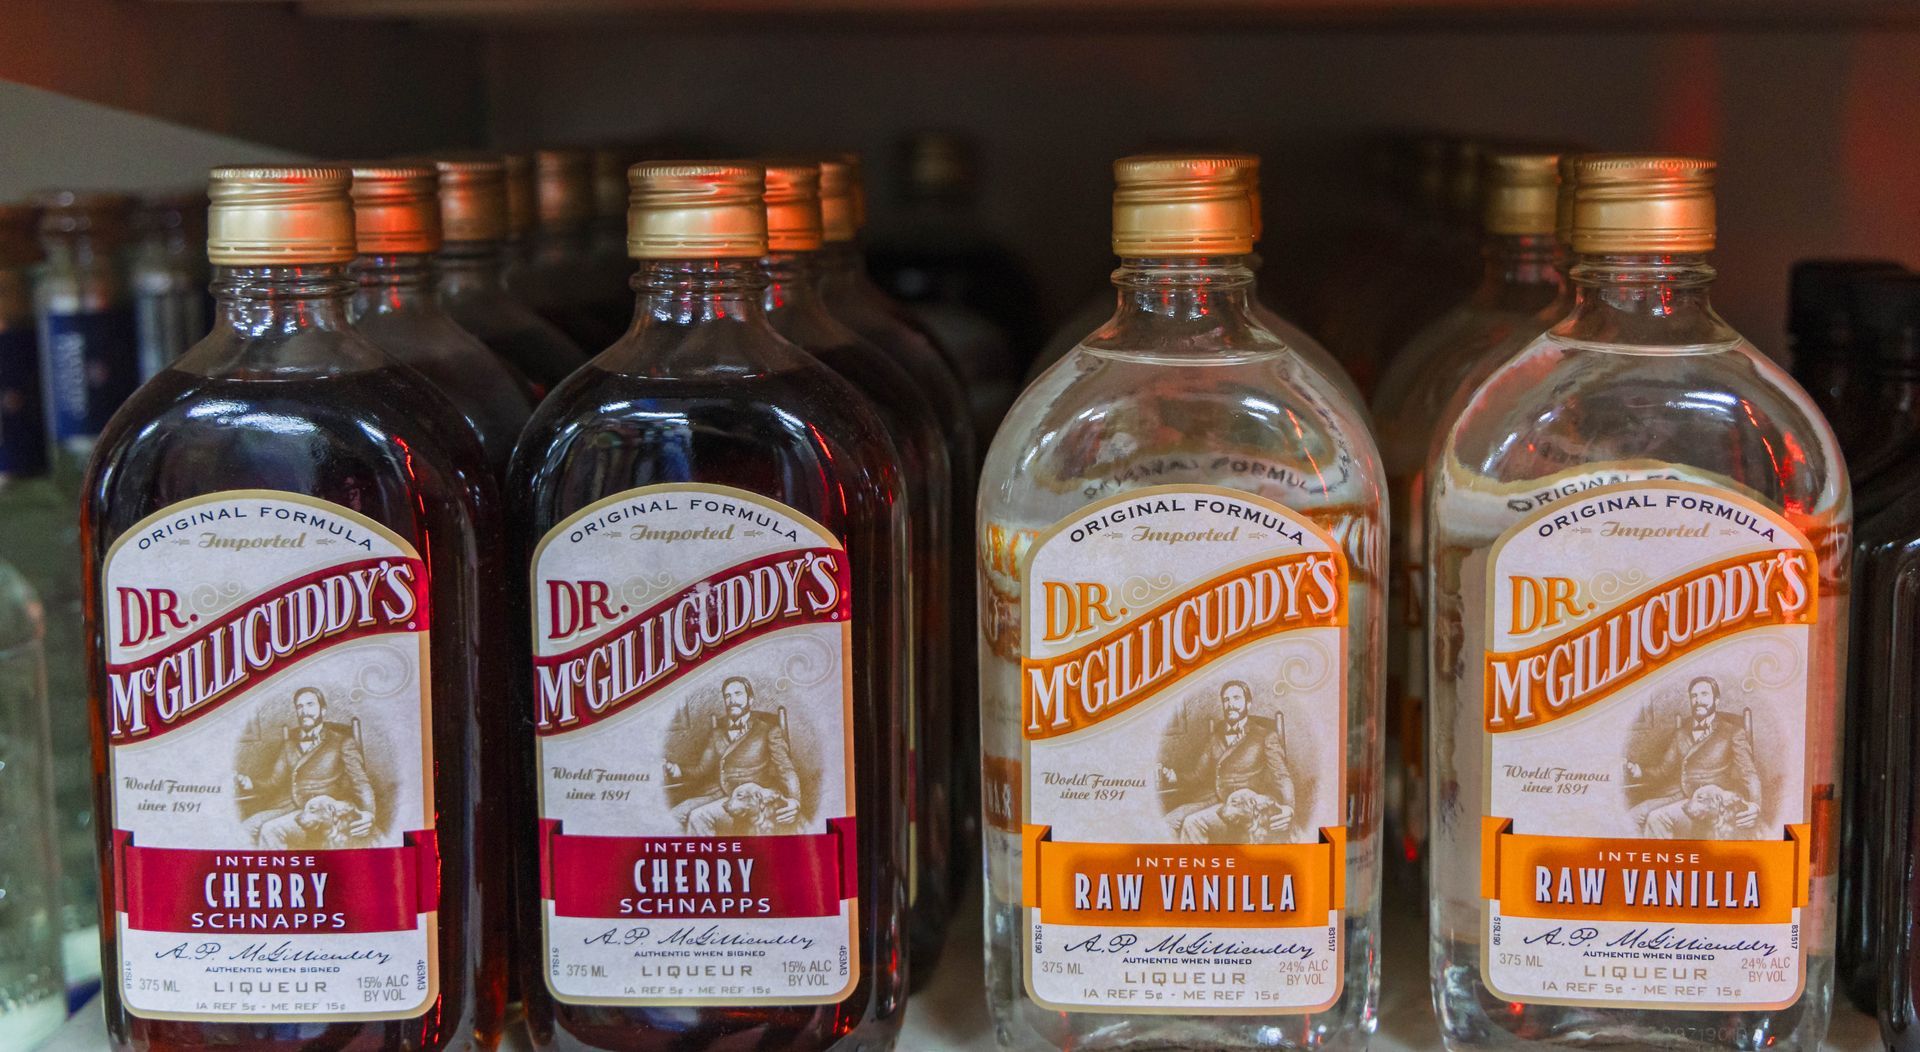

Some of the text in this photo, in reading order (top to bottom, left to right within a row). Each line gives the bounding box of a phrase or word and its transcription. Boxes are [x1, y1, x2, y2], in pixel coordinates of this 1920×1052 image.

[570, 499, 798, 543] ORIGINAL FORMULA
[1069, 499, 1304, 546] ORIGINAL FORMULA
[1538, 495, 1776, 543] ORIGINAL FORMULA
[138, 507, 372, 551] ORIGINAL FORMULA
[630, 524, 735, 544] Imported
[1131, 525, 1239, 545] Imported
[1600, 521, 1709, 540] Imported
[199, 532, 306, 551] Imported
[546, 580, 629, 639] DR.
[1042, 581, 1128, 641] DR.
[1508, 575, 1595, 634] DR.
[116, 586, 198, 647] DR.
[551, 766, 650, 783] World Famous
[1041, 772, 1147, 787] World Famous
[1503, 765, 1611, 782] World Famous
[123, 777, 222, 794] World Famous
[1521, 782, 1589, 795] since 1891
[566, 788, 630, 801] since 1891
[1059, 788, 1125, 801] since 1891
[137, 799, 201, 813] since 1891
[644, 842, 742, 852] INTENSE
[216, 855, 316, 867] INTENSE
[1136, 857, 1235, 868] INTENSE
[1599, 852, 1700, 864] INTENSE
[633, 858, 754, 893] CHERRY
[204, 872, 329, 908] CHERRY
[1075, 873, 1297, 912] RAW VANILLA
[1535, 865, 1759, 907] RAW VANILLA
[620, 898, 771, 913] SCHNAPPS
[191, 912, 346, 929] SCHNAPPS
[1328, 927, 1336, 951] 831517
[1493, 917, 1501, 946] 51SL190
[838, 945, 848, 976] 463M3
[1500, 953, 1543, 967] 375 ML
[1583, 951, 1639, 959] AUTHENTIC
[567, 964, 608, 978] 375 ML
[782, 960, 832, 973] 15% ALC
[1042, 961, 1084, 975] 375 ML
[1279, 959, 1328, 973] 24% ALC
[1741, 957, 1791, 970] 24% ALC
[417, 959, 426, 990] 463M3
[642, 966, 753, 978] LIQUEUR
[1125, 972, 1246, 985] LIQUEUR
[1286, 973, 1324, 986] BY VOL
[1584, 965, 1707, 980] LIQUEUR
[1749, 970, 1786, 982] BY VOL
[140, 979, 180, 992] 375 ML
[357, 974, 409, 989] 15% ALC
[788, 974, 829, 986] BY VOL
[214, 981, 327, 995] LIQUEUR
[364, 988, 406, 1002] BY VOL
[1084, 989, 1099, 998] IA
[1107, 989, 1137, 998] REF
[1184, 991, 1206, 1000] ME
[1214, 991, 1245, 1000] REF
[1542, 981, 1558, 991] IA
[1566, 983, 1598, 992] REF
[1643, 985, 1667, 995] ME
[1675, 986, 1706, 996] REF
[196, 1002, 208, 1010] IA
[213, 1002, 237, 1010] REF
[271, 1002, 289, 1010] ME
[295, 1002, 319, 1010] REF
